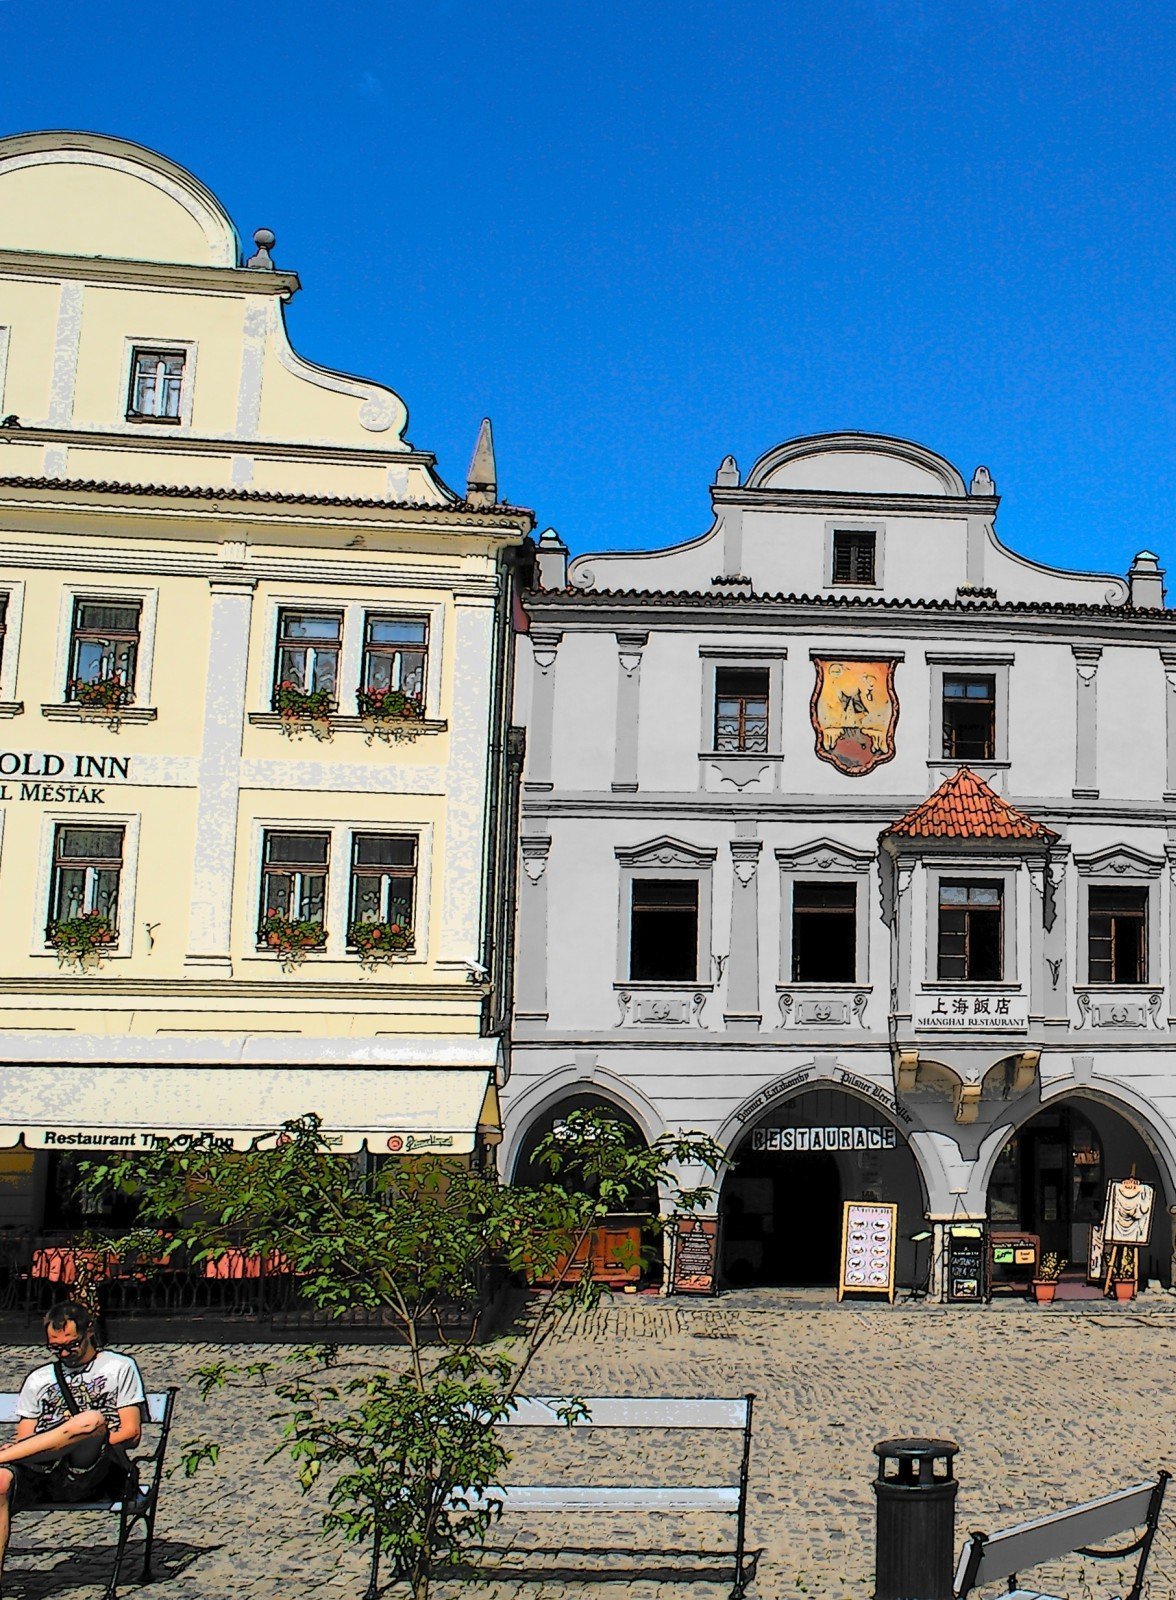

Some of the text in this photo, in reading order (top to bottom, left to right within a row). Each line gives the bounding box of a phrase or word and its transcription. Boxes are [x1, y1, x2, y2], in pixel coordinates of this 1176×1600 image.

[0, 753, 131, 779] OLD INN
[19, 783, 105, 803] MĚŠŤÁK
[931, 997, 1011, 1015] 上海飯店
[918, 1018, 1026, 1026] SHANGHAI RESTAURANT
[840, 1071, 872, 1092] Pilsner
[44, 1131, 136, 1146] Restaurant
[753, 1128, 894, 1149] RESTAURACE
